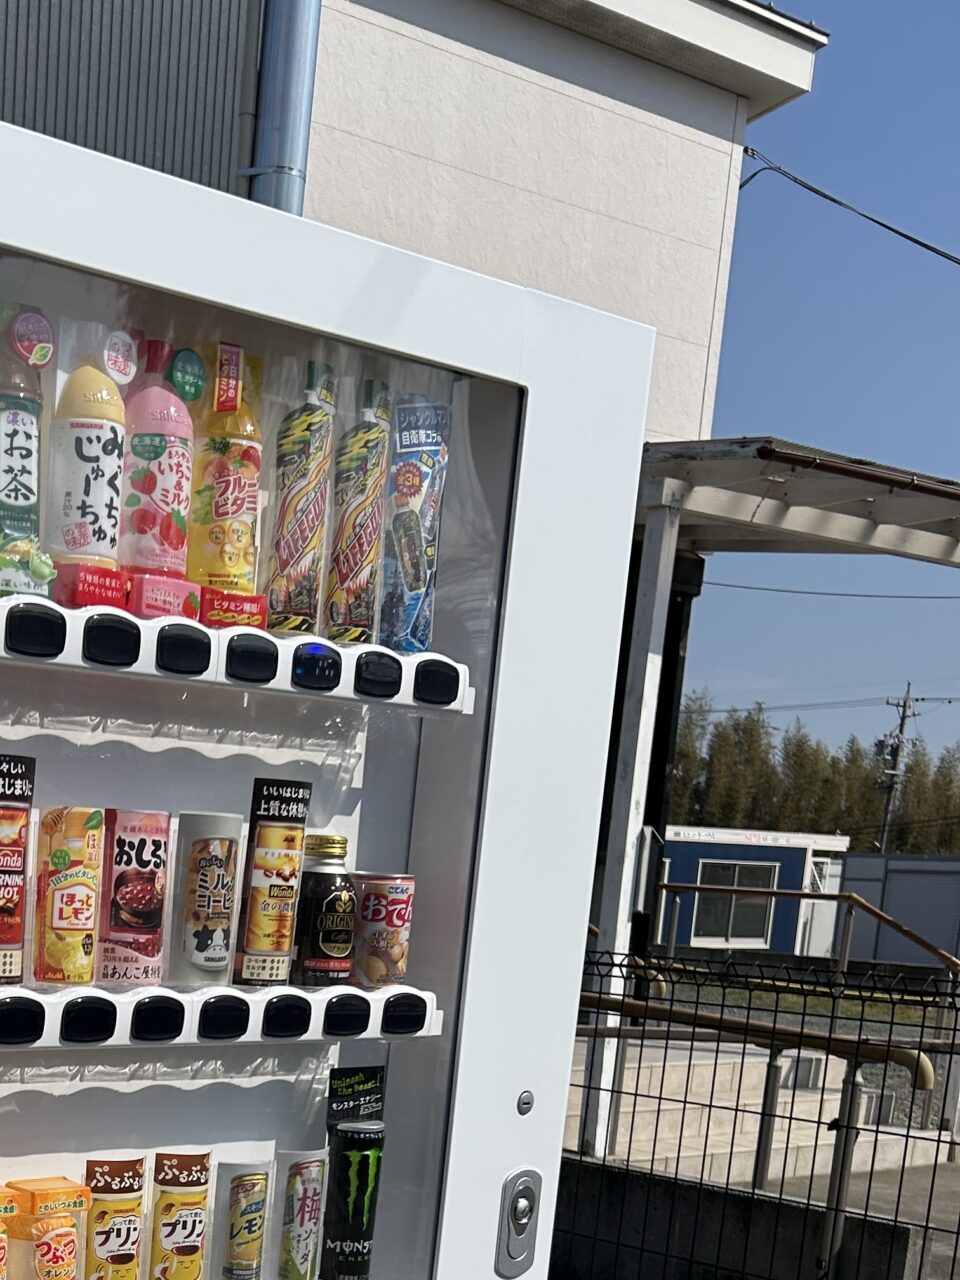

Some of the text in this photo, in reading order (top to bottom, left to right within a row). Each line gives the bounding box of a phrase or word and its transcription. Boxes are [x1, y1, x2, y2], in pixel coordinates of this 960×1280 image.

[6, 412, 35, 427] 濃い
[174, 480, 184, 493] &
[114, 834, 167, 869] おしる
[199, 856, 224, 869] おいしい
[60, 892, 93, 907] ほっと
[58, 906, 94, 921] レモン
[331, 1094, 382, 1110] モンスターエナジー
[34, 1238, 76, 1265] つぶつ
